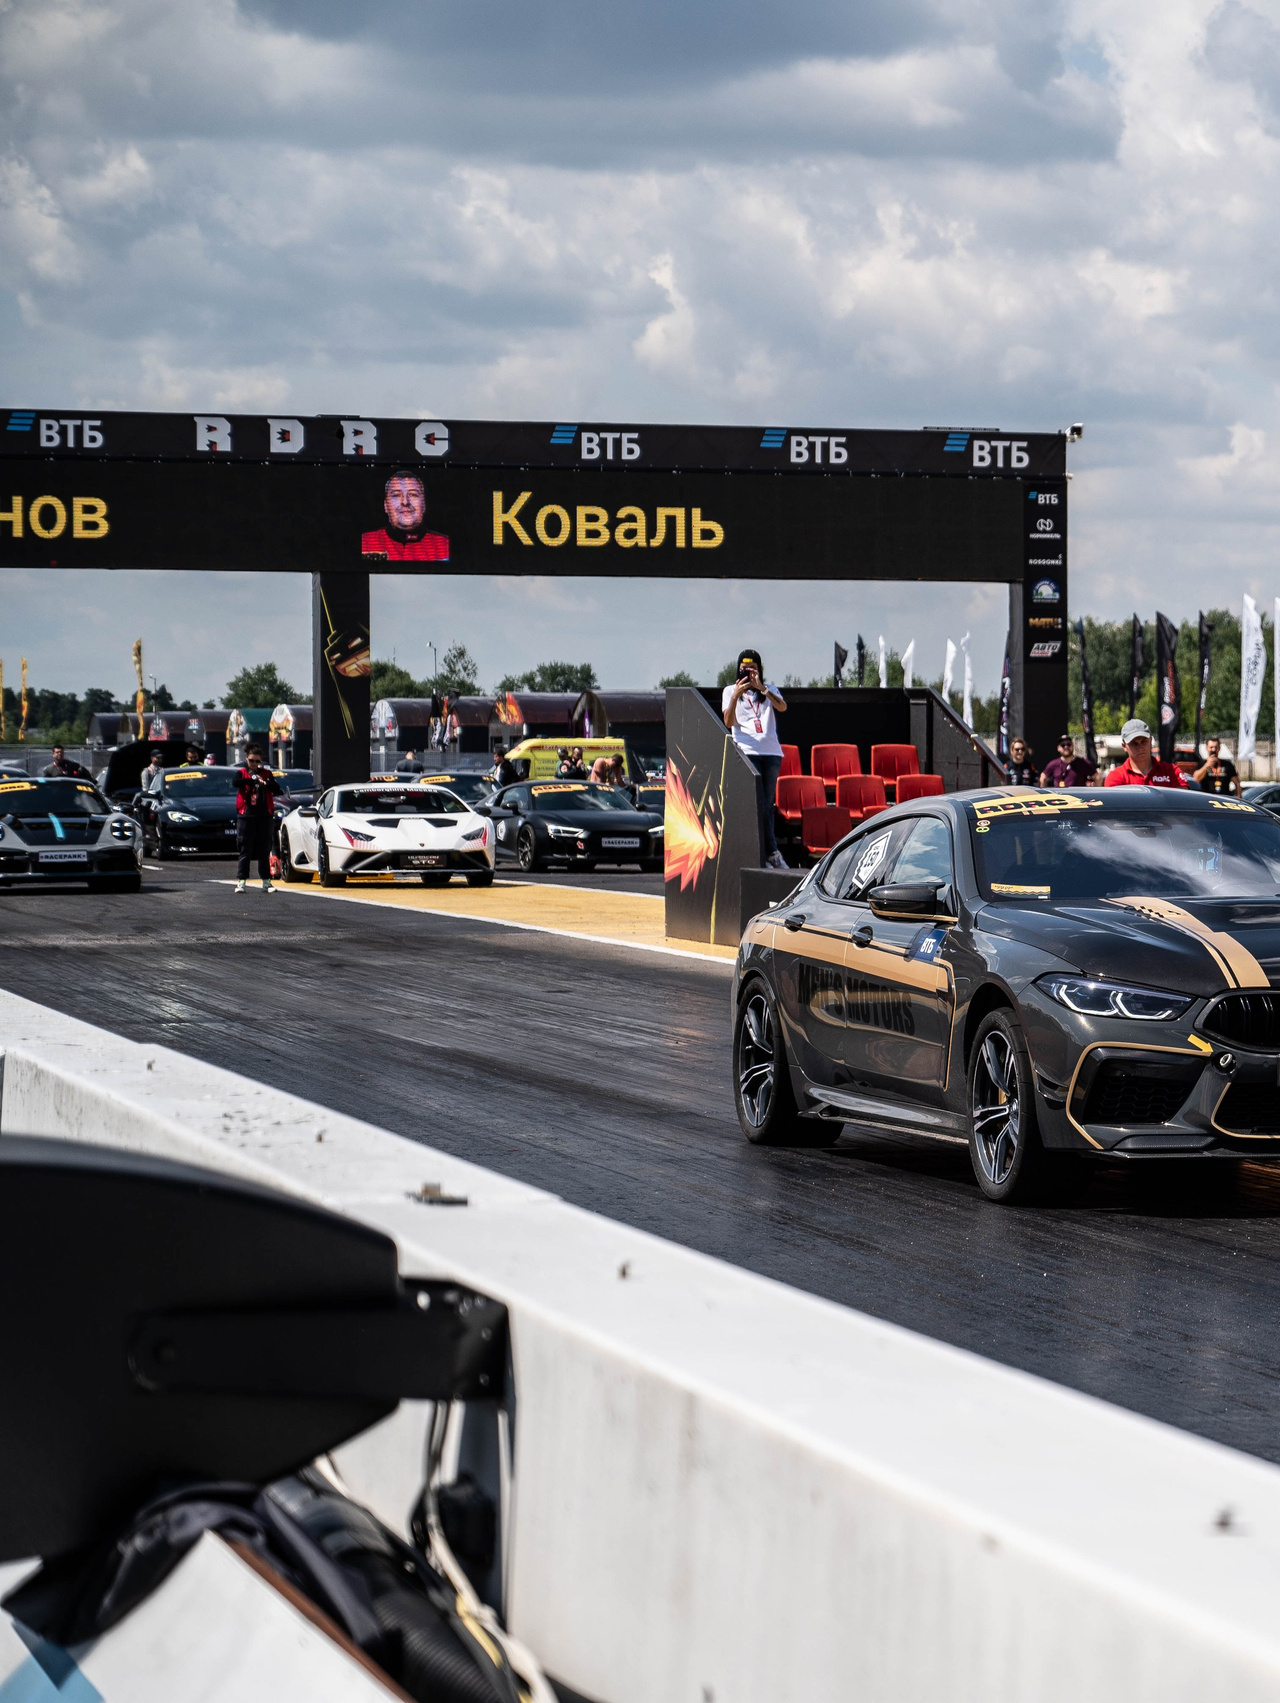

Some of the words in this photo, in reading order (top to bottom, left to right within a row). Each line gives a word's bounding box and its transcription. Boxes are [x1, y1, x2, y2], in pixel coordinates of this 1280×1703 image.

[39, 419, 103, 448] ВТБ
[580, 432, 641, 460] ВТБ
[789, 436, 848, 464] ВТБ
[971, 440, 1030, 468] ВТБ
[1037, 493, 1059, 504] ВТБ
[491, 490, 725, 550] Коваль
[978, 799, 1069, 815] RDRC
[1208, 800, 1257, 813] 150
[920, 937, 937, 953] ВТБ
